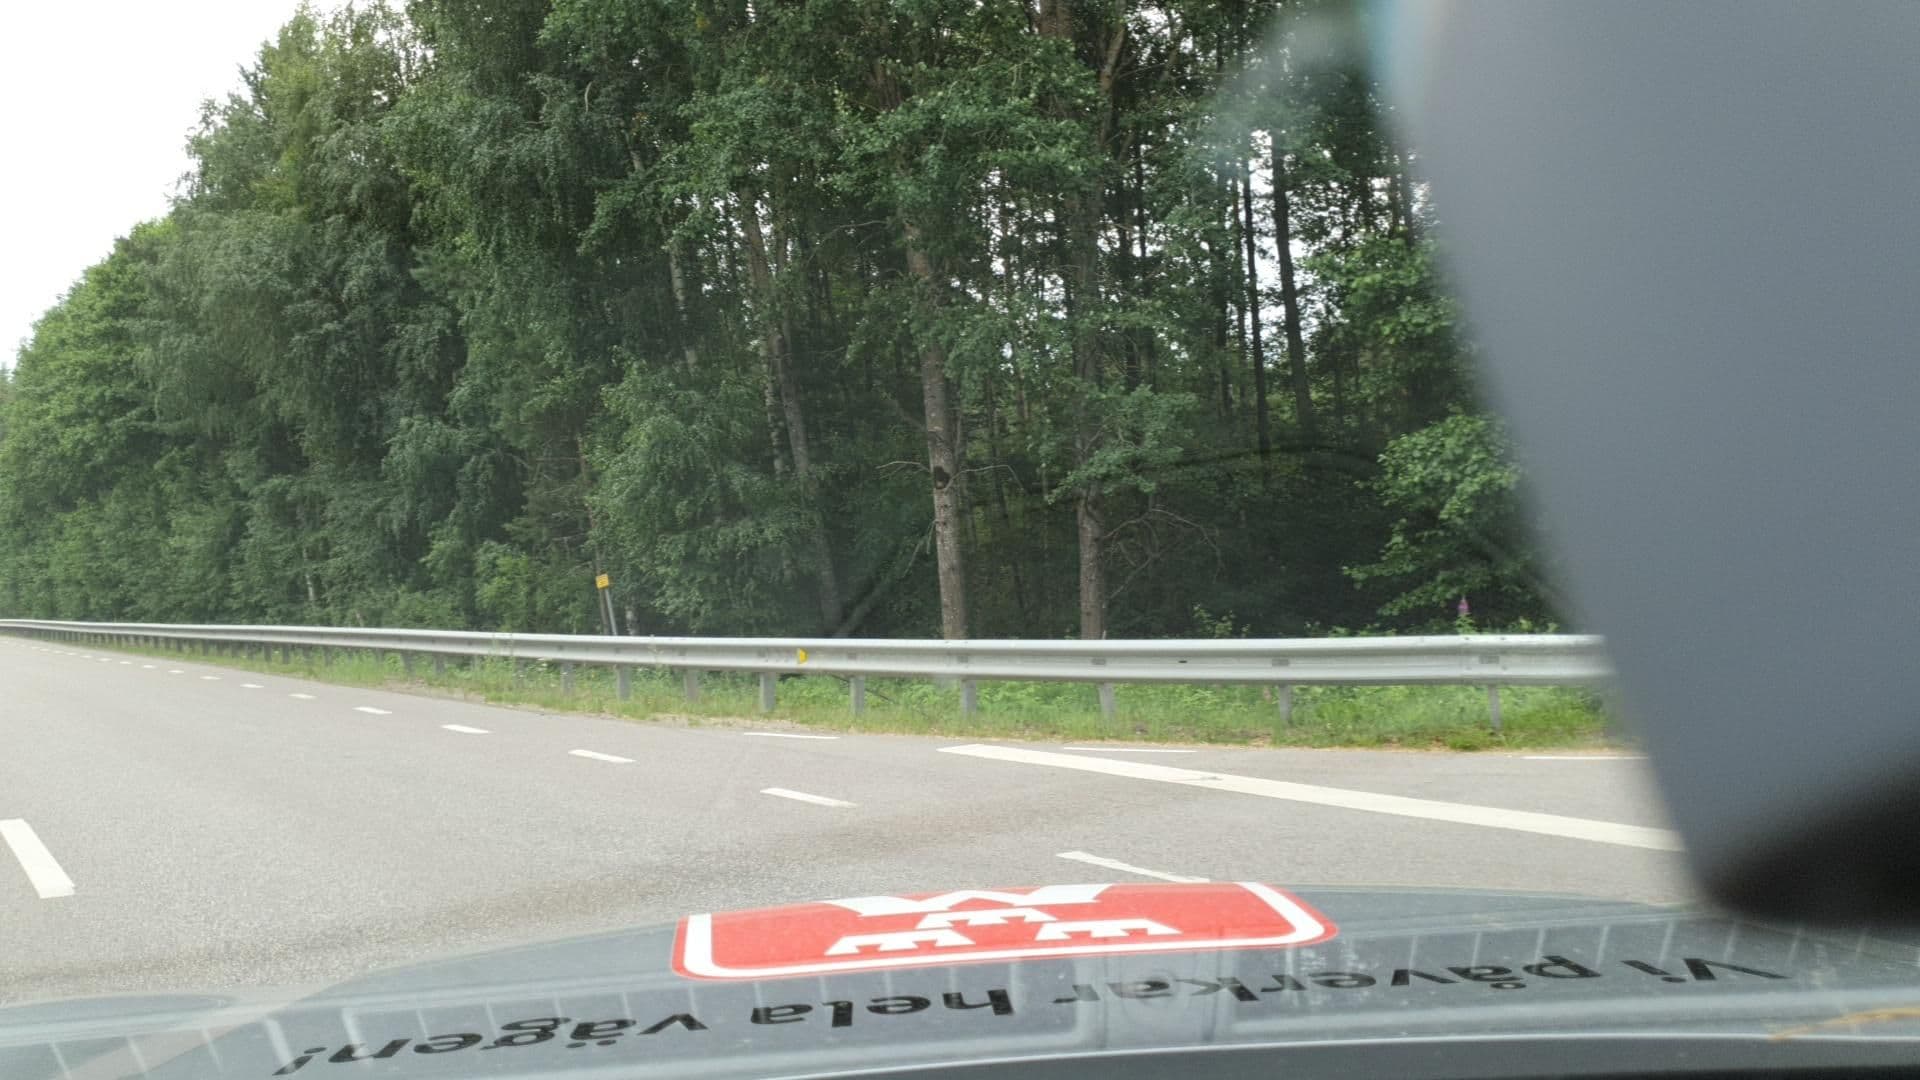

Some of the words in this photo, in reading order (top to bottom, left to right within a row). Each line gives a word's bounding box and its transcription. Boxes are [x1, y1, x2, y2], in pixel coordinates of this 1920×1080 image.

[1053, 955, 1602, 1002] påverkar
[1621, 957, 1790, 983] Vi
[750, 985, 1014, 1027] hela
[272, 1013, 708, 1075] vägen!
